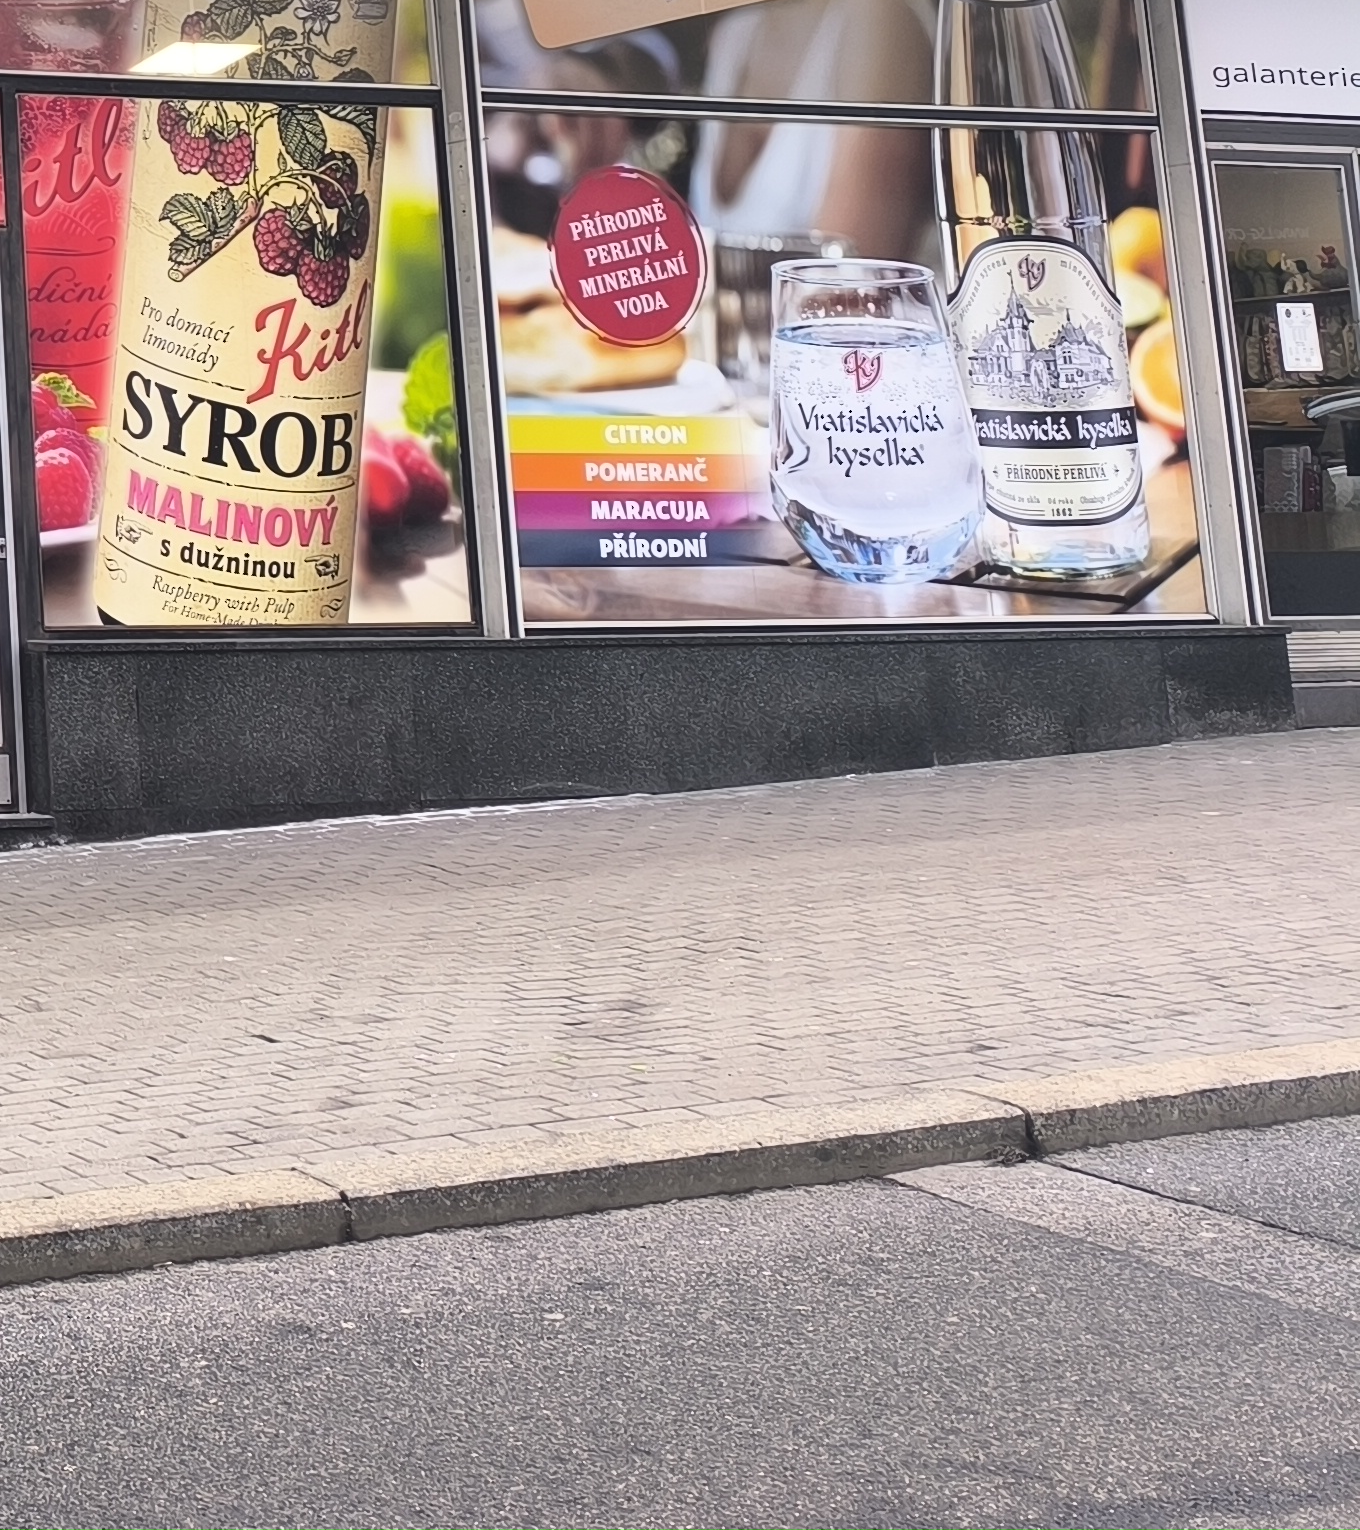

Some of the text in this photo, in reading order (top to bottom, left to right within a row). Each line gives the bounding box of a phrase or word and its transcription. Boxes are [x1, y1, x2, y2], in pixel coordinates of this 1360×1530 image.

[568, 197, 668, 242] PŘÍRODNĚ
[584, 226, 669, 267] PERLIVÁ
[578, 249, 689, 298] MINERÁLNÍ
[140, 296, 235, 344] Pro domácí
[613, 290, 670, 319] VODA
[142, 325, 220, 373] limonády
[246, 278, 372, 404] Kitl
[122, 370, 354, 478] SYROB
[604, 424, 688, 445] CITRON
[797, 402, 945, 434] Vratislavická
[1076, 412, 1133, 449] kyselka
[584, 456, 709, 483] POMERANČ
[826, 435, 925, 478] kyselka
[1007, 462, 1108, 481] PŘÍRODNĚ PERLIVÁ
[127, 468, 339, 548] MALINOVÝ
[590, 500, 711, 523] MARACUJA
[1051, 507, 1073, 517] 1862
[159, 538, 296, 580] s dužninou
[599, 531, 708, 558] PŘÍRODNÍ
[152, 575, 296, 620] Raspberry with Pulp
[161, 600, 178, 614] For
